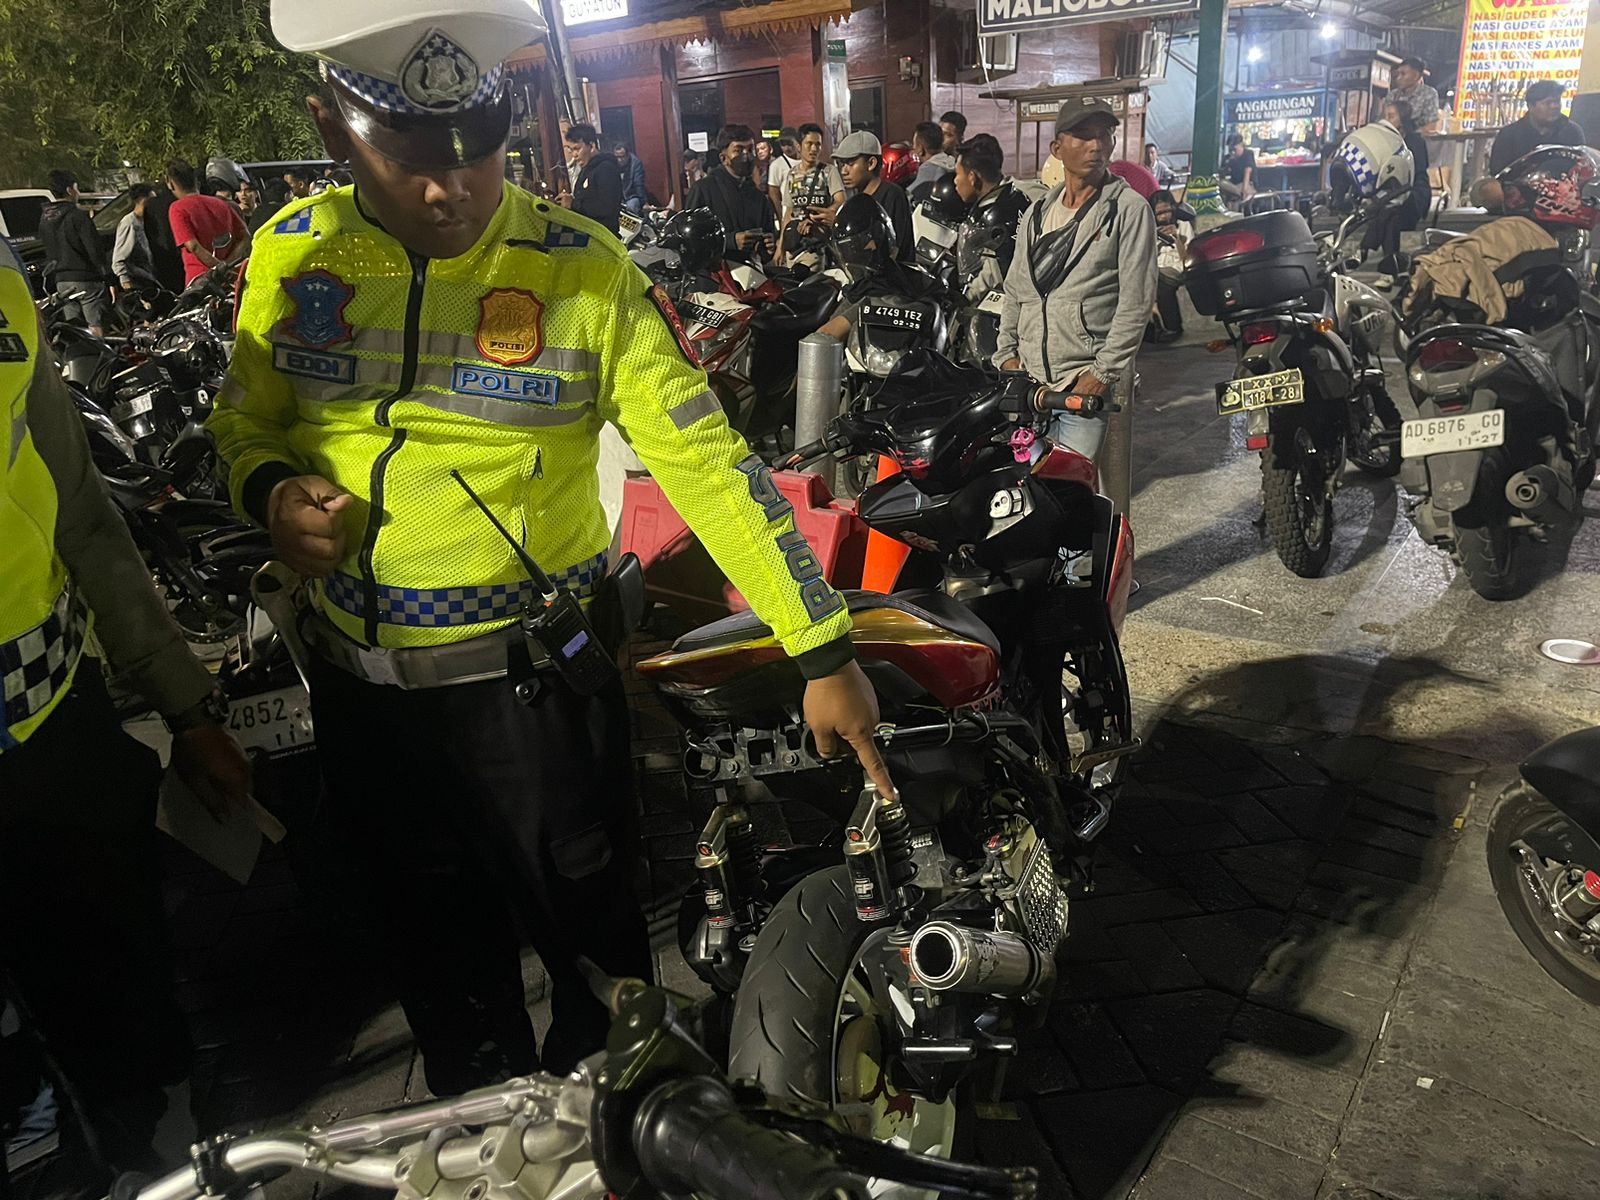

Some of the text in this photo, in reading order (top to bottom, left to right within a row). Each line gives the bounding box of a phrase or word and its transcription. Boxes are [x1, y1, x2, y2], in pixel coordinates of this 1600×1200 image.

[1473, 21, 1500, 31] NASI
[1504, 20, 1545, 30] GUDEG
[1546, 39, 1580, 49] AYAM
[1235, 95, 1315, 113] ANGKRINGAN
[985, 294, 1001, 303] AB
[863, 305, 922, 321] B 4749 TEZ
[490, 341, 525, 352] POLISI
[460, 371, 552, 398] POLRI
[1404, 423, 1423, 439] AD
[1427, 418, 1465, 436] 6876
